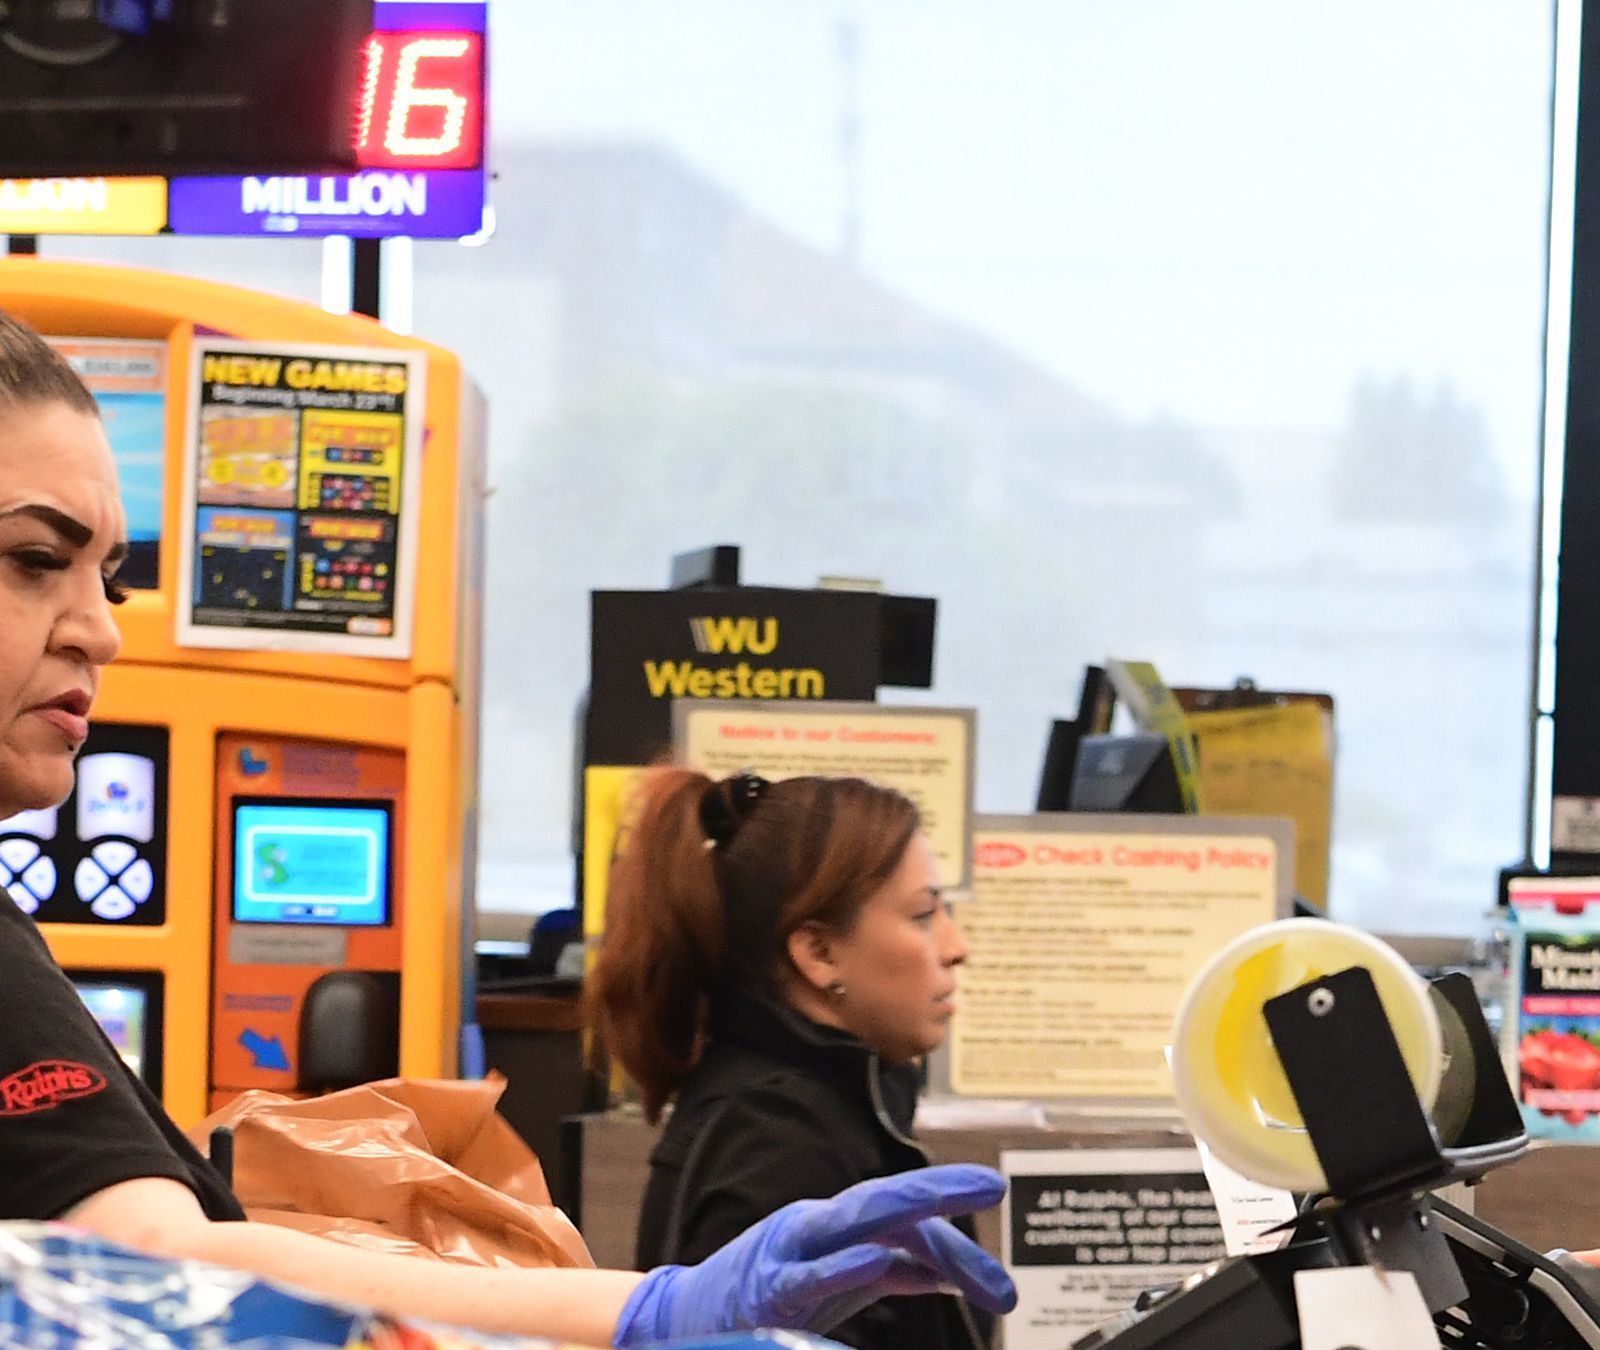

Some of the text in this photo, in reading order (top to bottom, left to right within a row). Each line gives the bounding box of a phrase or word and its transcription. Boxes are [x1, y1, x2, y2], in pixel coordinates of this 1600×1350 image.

[242, 174, 426, 215] MILLION
[203, 354, 407, 394] NEW GAMES
[689, 615, 779, 655] WU
[643, 660, 825, 698] Western
[1032, 843, 1103, 866] Check
[1111, 845, 1200, 872] Cashing
